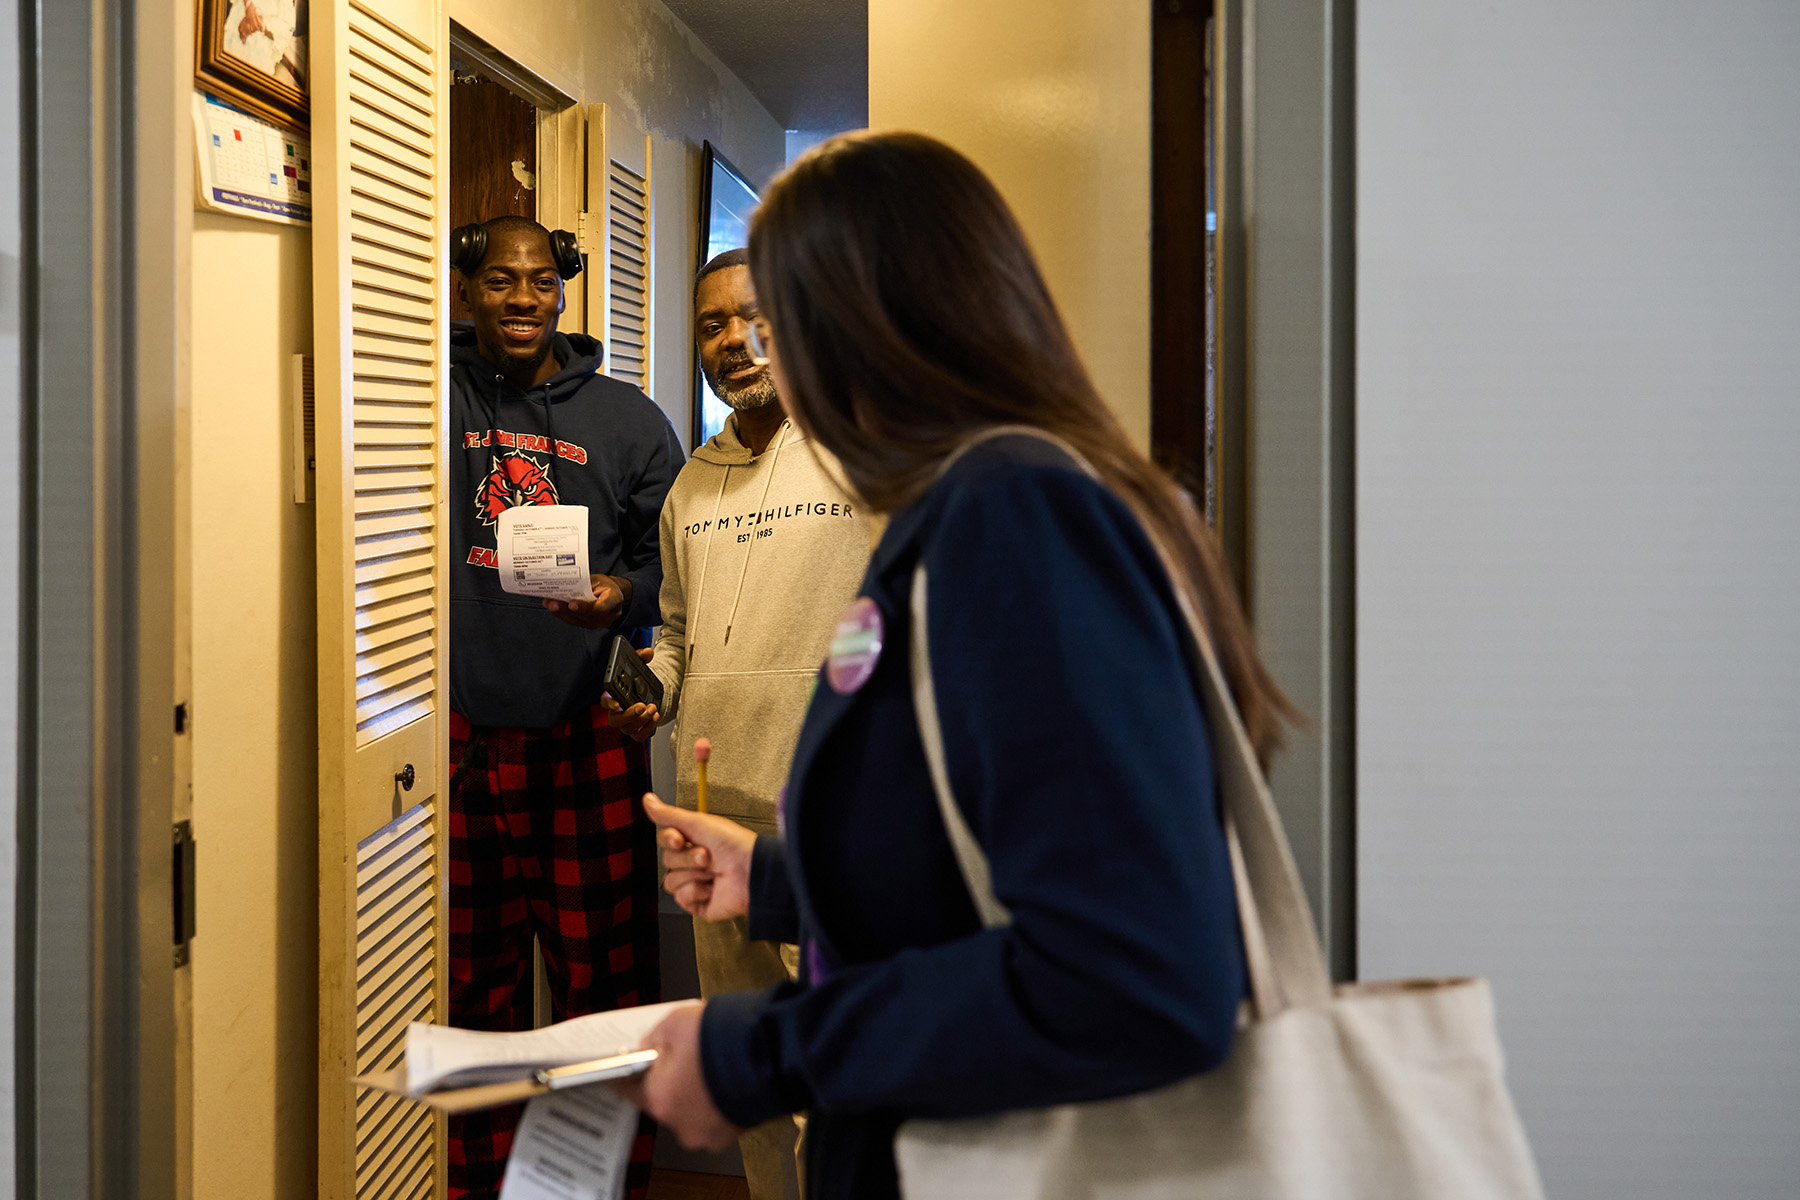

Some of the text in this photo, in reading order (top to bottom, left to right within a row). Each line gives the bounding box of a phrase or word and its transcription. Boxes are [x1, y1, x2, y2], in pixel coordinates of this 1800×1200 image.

[482, 429, 515, 447] JNE
[516, 433, 588, 465] FRANCES
[765, 503, 853, 522] HILFIGER
[756, 528, 773, 540] 1985
